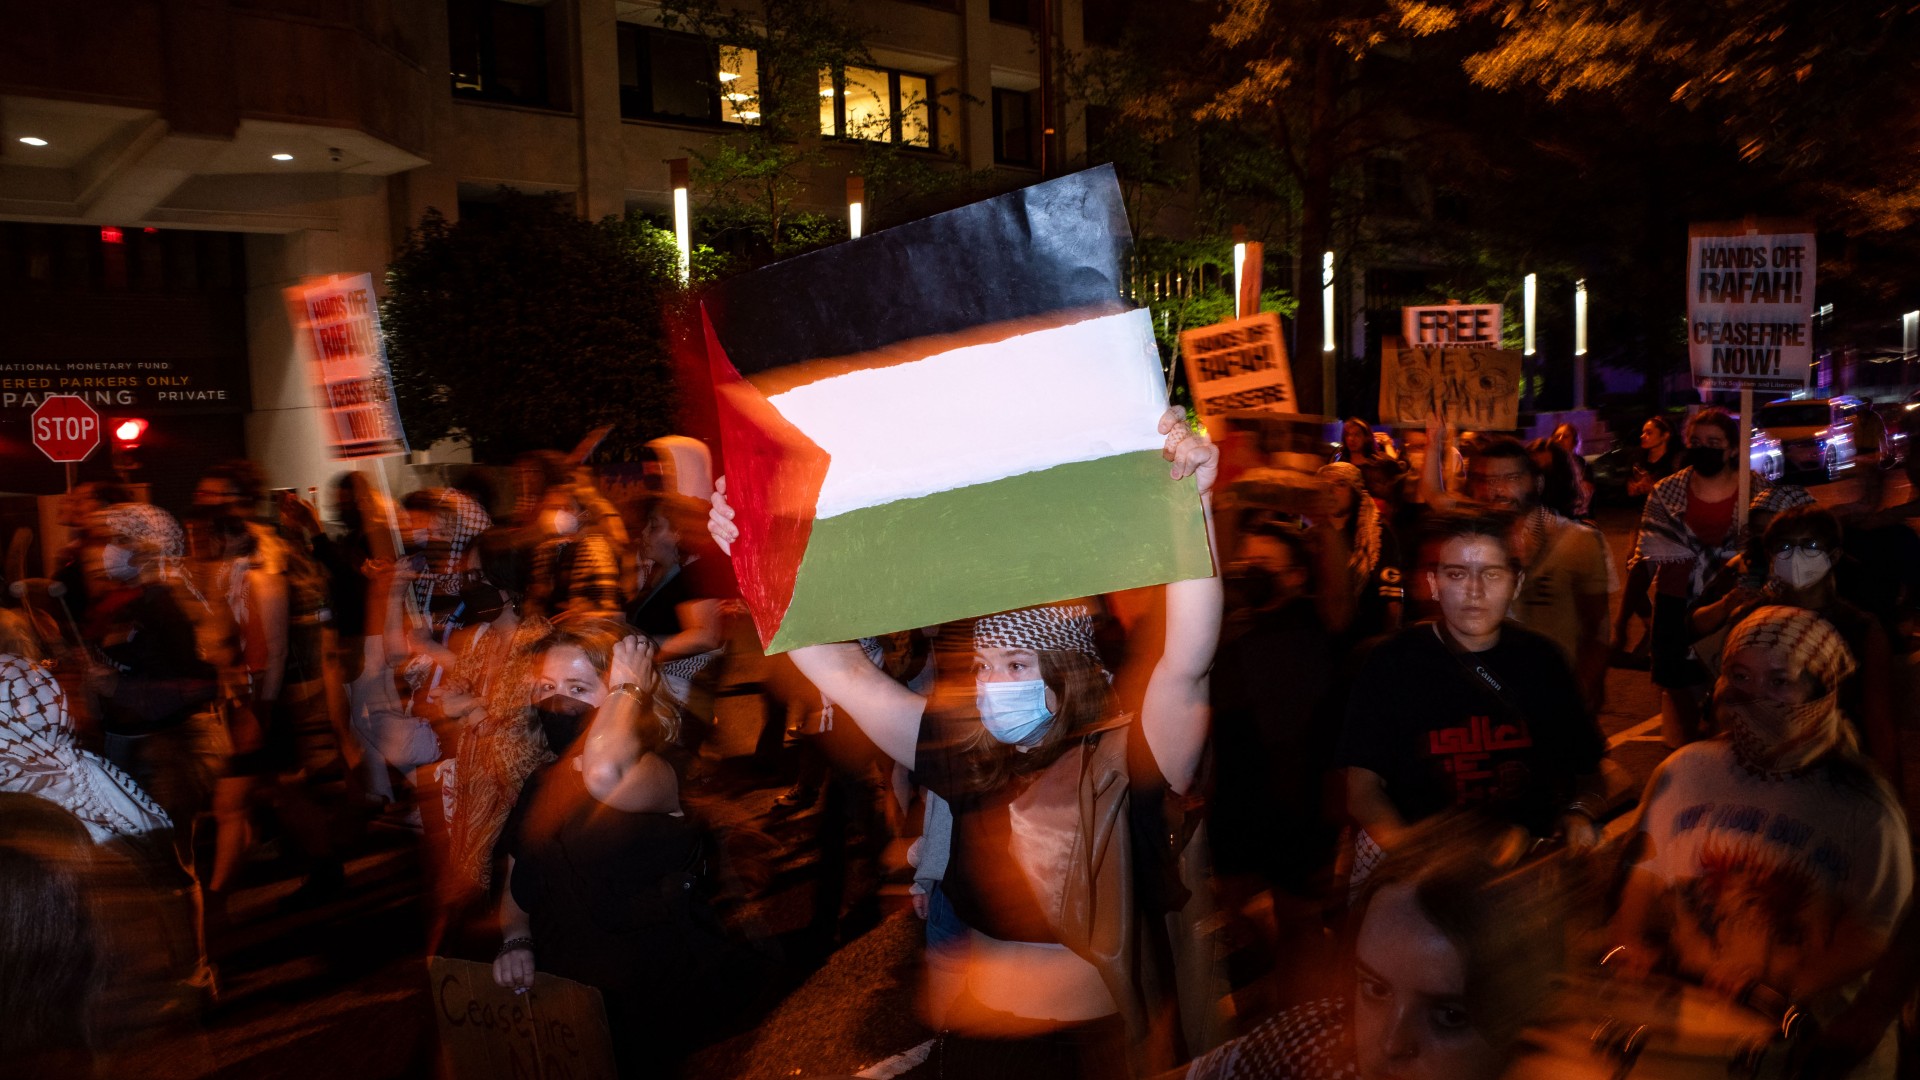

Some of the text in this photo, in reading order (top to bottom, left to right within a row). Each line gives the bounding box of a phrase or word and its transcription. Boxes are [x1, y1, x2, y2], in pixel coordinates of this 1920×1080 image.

[1701, 246, 1805, 269] HANDS OFF
[1698, 271, 1803, 304] RAFAH!
[1416, 309, 1494, 343] FREE
[1693, 322, 1806, 347] CEASEFIRE
[66, 362, 132, 370] MONETARY
[137, 361, 169, 369] FUND
[1712, 347, 1781, 375] NOW!
[60, 376, 138, 387] PARKERS
[146, 375, 190, 386] ONLY
[3, 390, 227, 408] PAING PRIVATE
[37, 416, 95, 442] STOP
[1475, 665, 1502, 692] Canon
